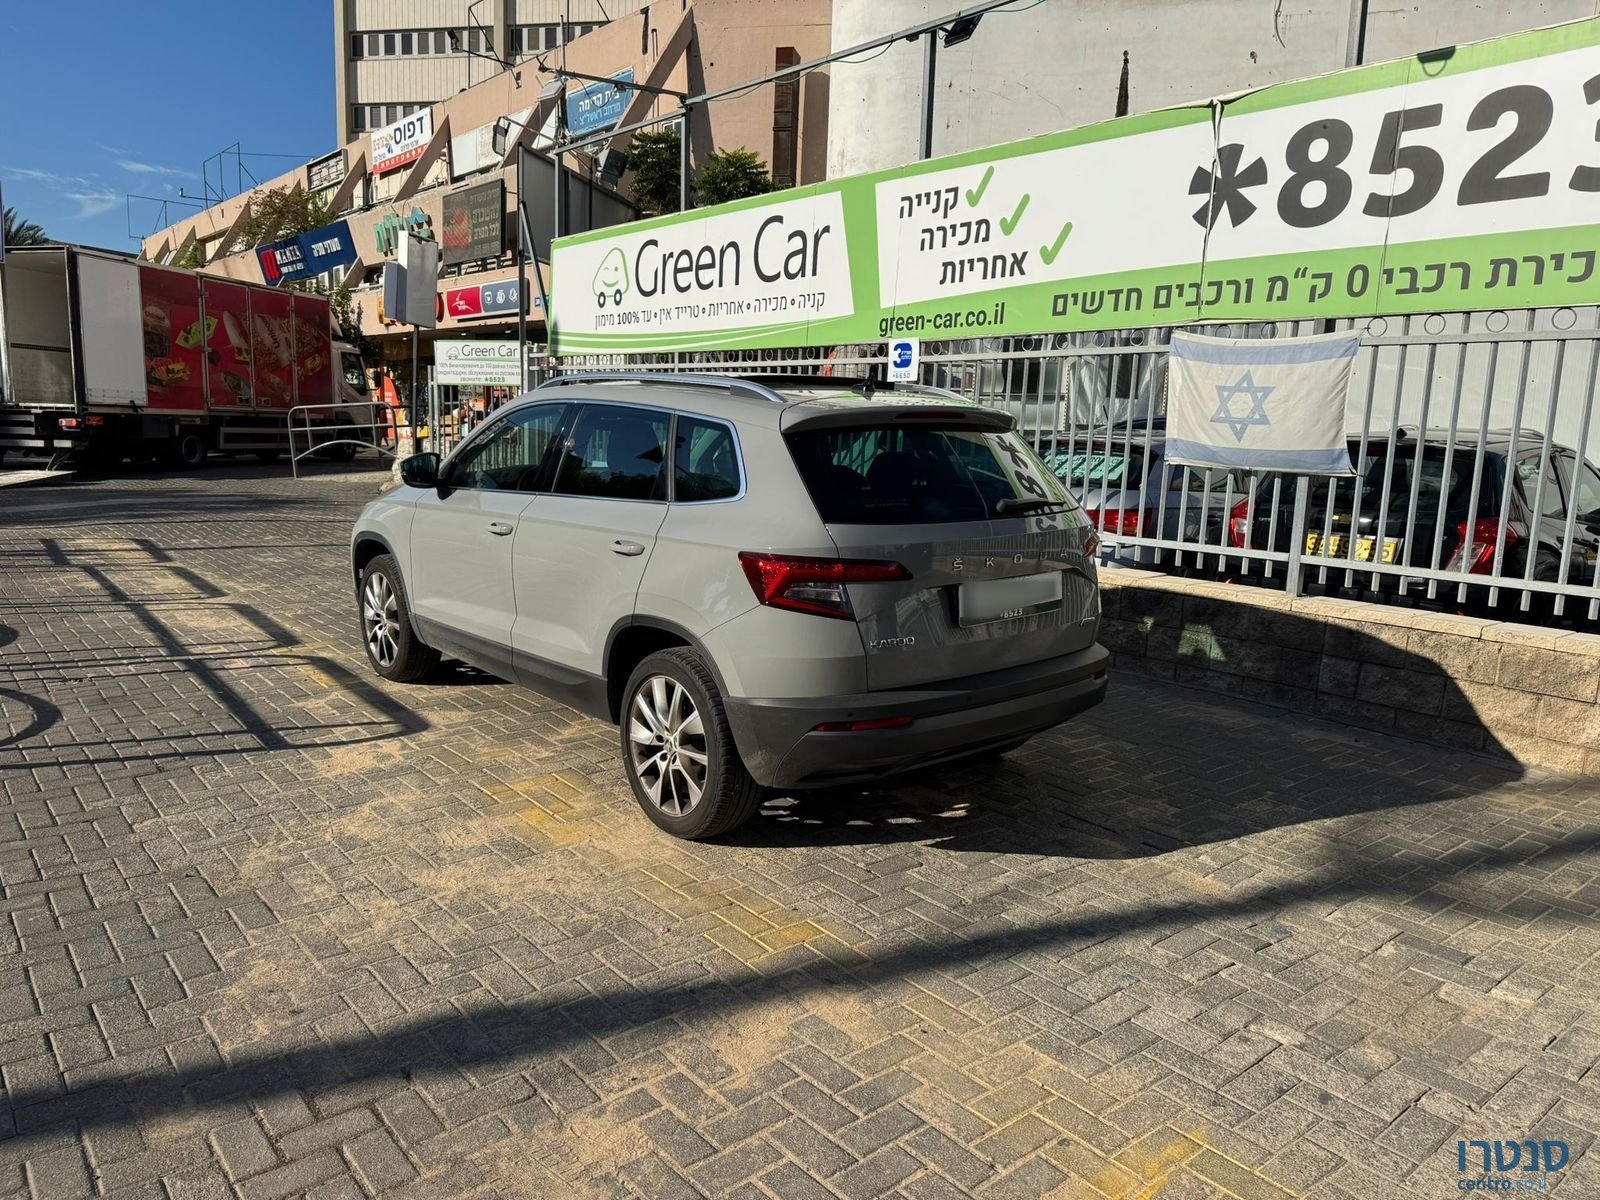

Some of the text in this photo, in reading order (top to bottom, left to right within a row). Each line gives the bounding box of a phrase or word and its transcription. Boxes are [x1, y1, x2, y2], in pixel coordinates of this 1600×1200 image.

[393, 115, 424, 146] דפוס
[899, 186, 959, 219] קנייה
[920, 218, 991, 251] מכירה
[635, 215, 831, 297] Green Car
[939, 251, 1028, 285] אחריות
[1153, 278, 1254, 310] ורכבים
[1346, 263, 1370, 298] 0
[1382, 261, 1472, 296] רכבי
[594, 292, 826, 330] קניה מכירה אחריות טרייד אין עד 100% מימון
[1051, 287, 1143, 317] חדשים
[879, 302, 1006, 338] green-car.co.il
[461, 344, 518, 357] Green Car
